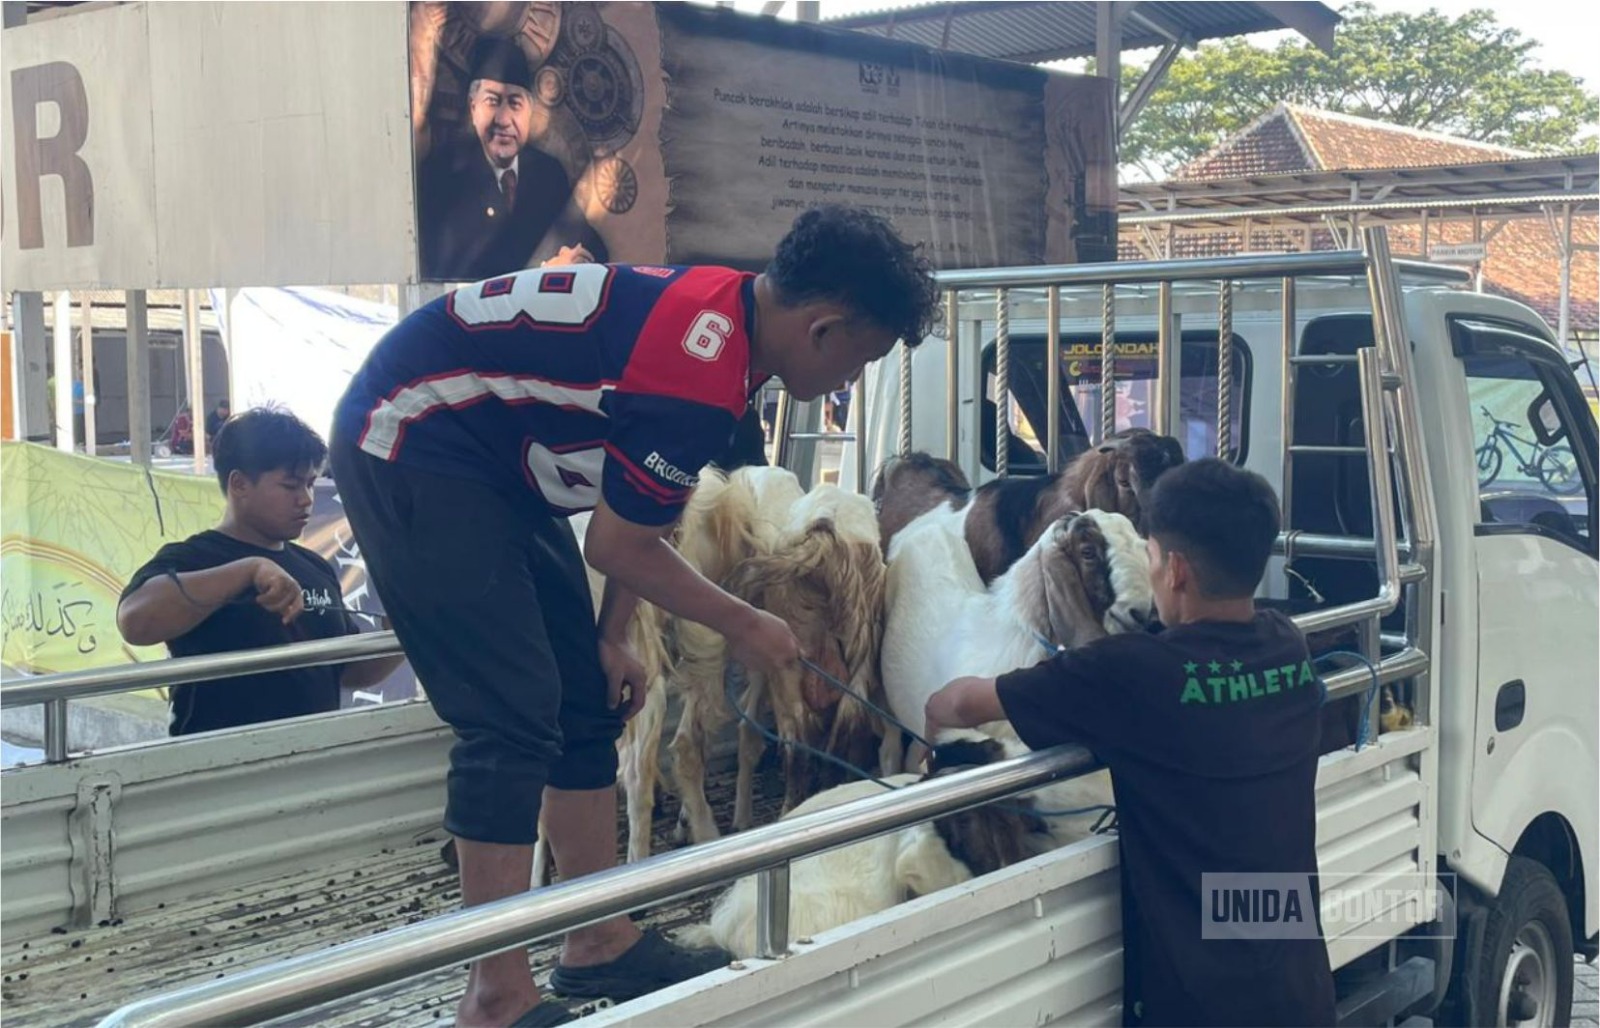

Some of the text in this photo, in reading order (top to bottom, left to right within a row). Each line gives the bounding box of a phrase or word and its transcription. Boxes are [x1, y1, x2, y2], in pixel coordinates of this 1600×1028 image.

[713, 88, 747, 104] Puncak
[757, 155, 775, 168] Adil
[1179, 659, 1314, 704] ATHLETA
